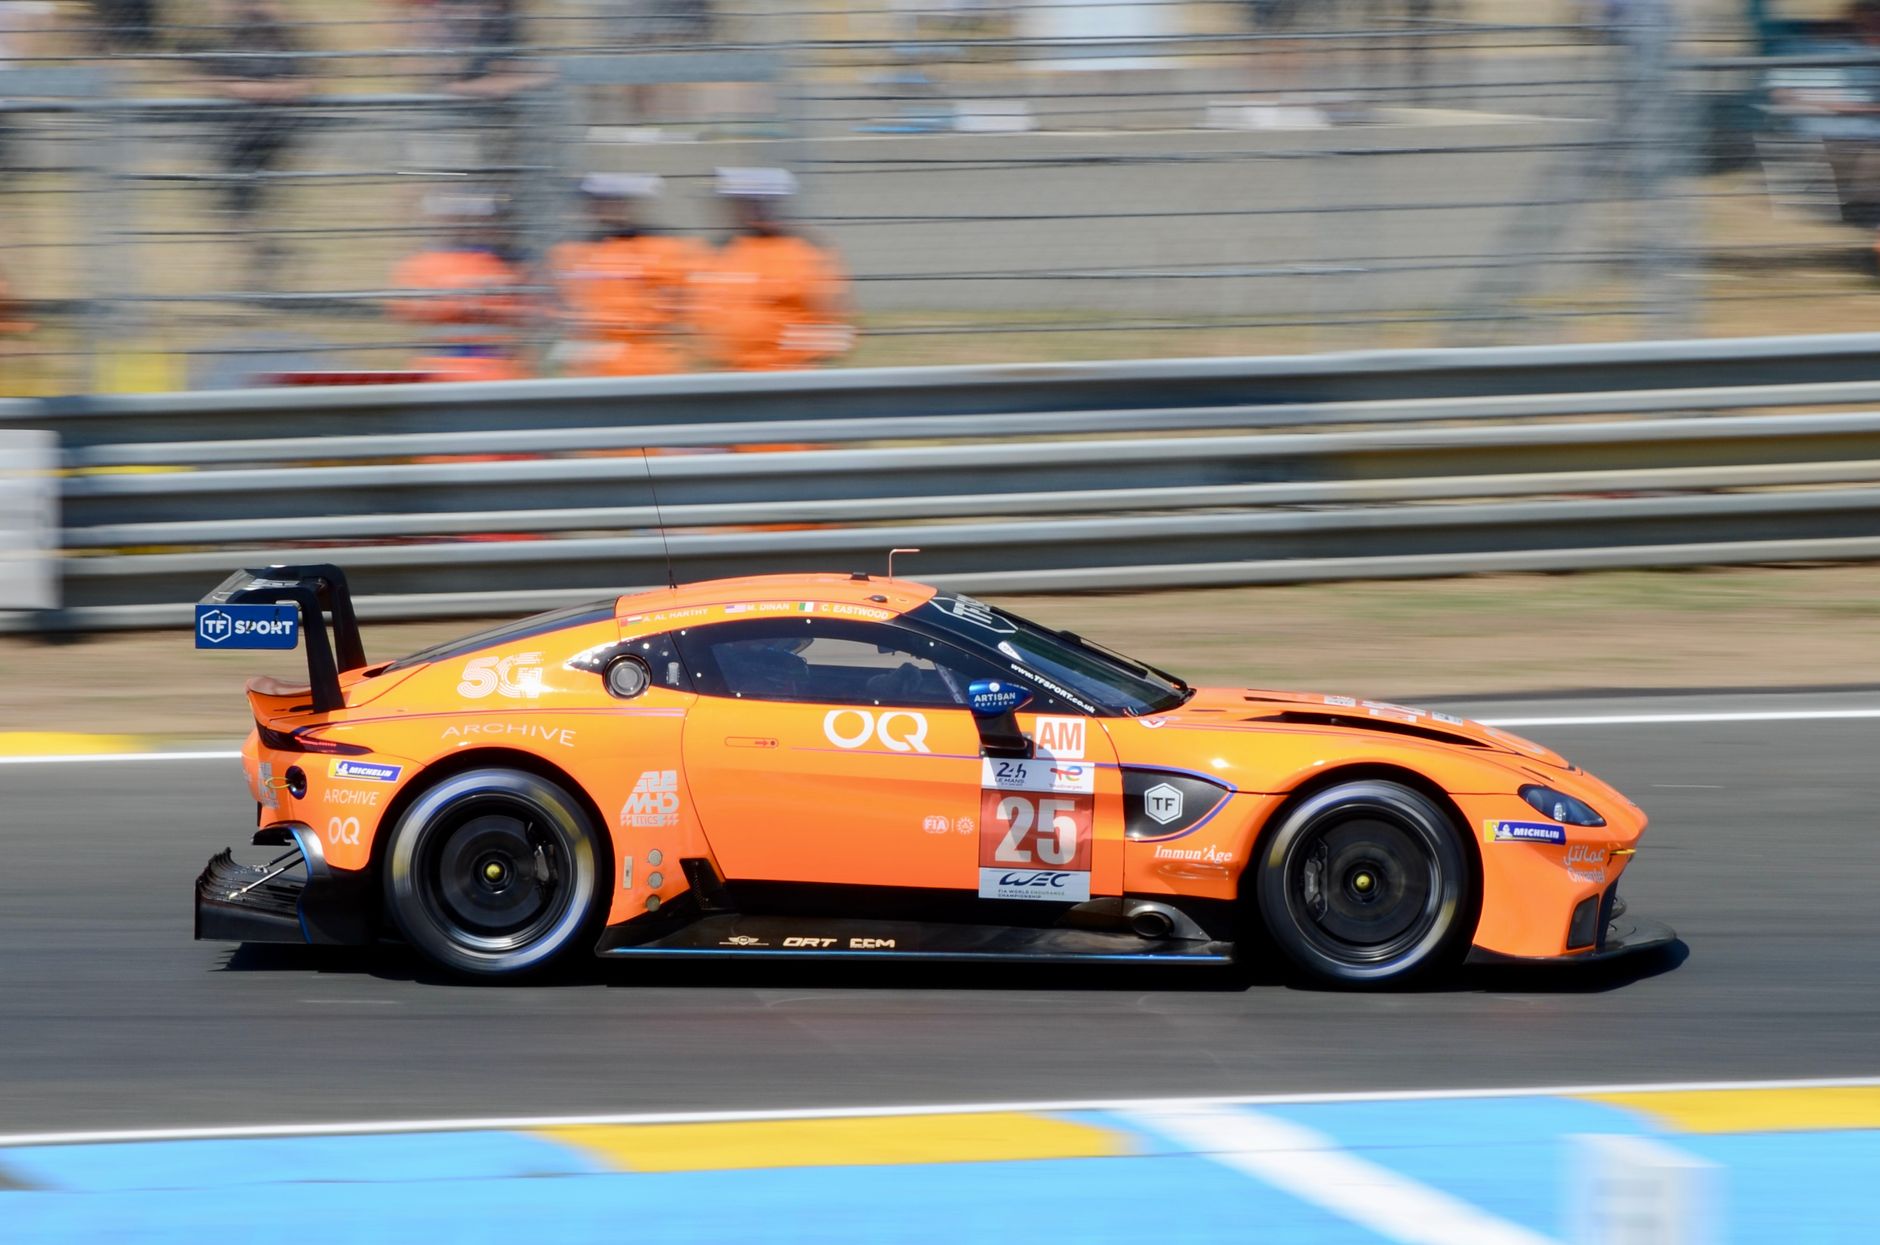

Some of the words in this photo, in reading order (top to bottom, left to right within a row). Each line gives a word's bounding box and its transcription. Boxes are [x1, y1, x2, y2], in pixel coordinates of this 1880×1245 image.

[832, 604, 889, 620] EASTWOOD
[205, 620, 227, 634] TF
[234, 620, 294, 635] SPORT
[456, 651, 545, 699] 5G
[974, 692, 1016, 702] ARTISAN
[440, 722, 577, 748] ARCHIVE
[823, 709, 932, 753] OQ
[1038, 722, 1081, 751] AM
[348, 766, 393, 777] MICHELIN
[323, 788, 380, 806] ARCHIVE
[1152, 797, 1176, 811] TF
[328, 816, 361, 846] OQ
[923, 818, 948, 831] FIA
[994, 796, 1078, 865] 25
[1513, 827, 1560, 839] MICHELIN
[1154, 844, 1233, 864] Immun'Âge
[998, 871, 1071, 888] WEC
